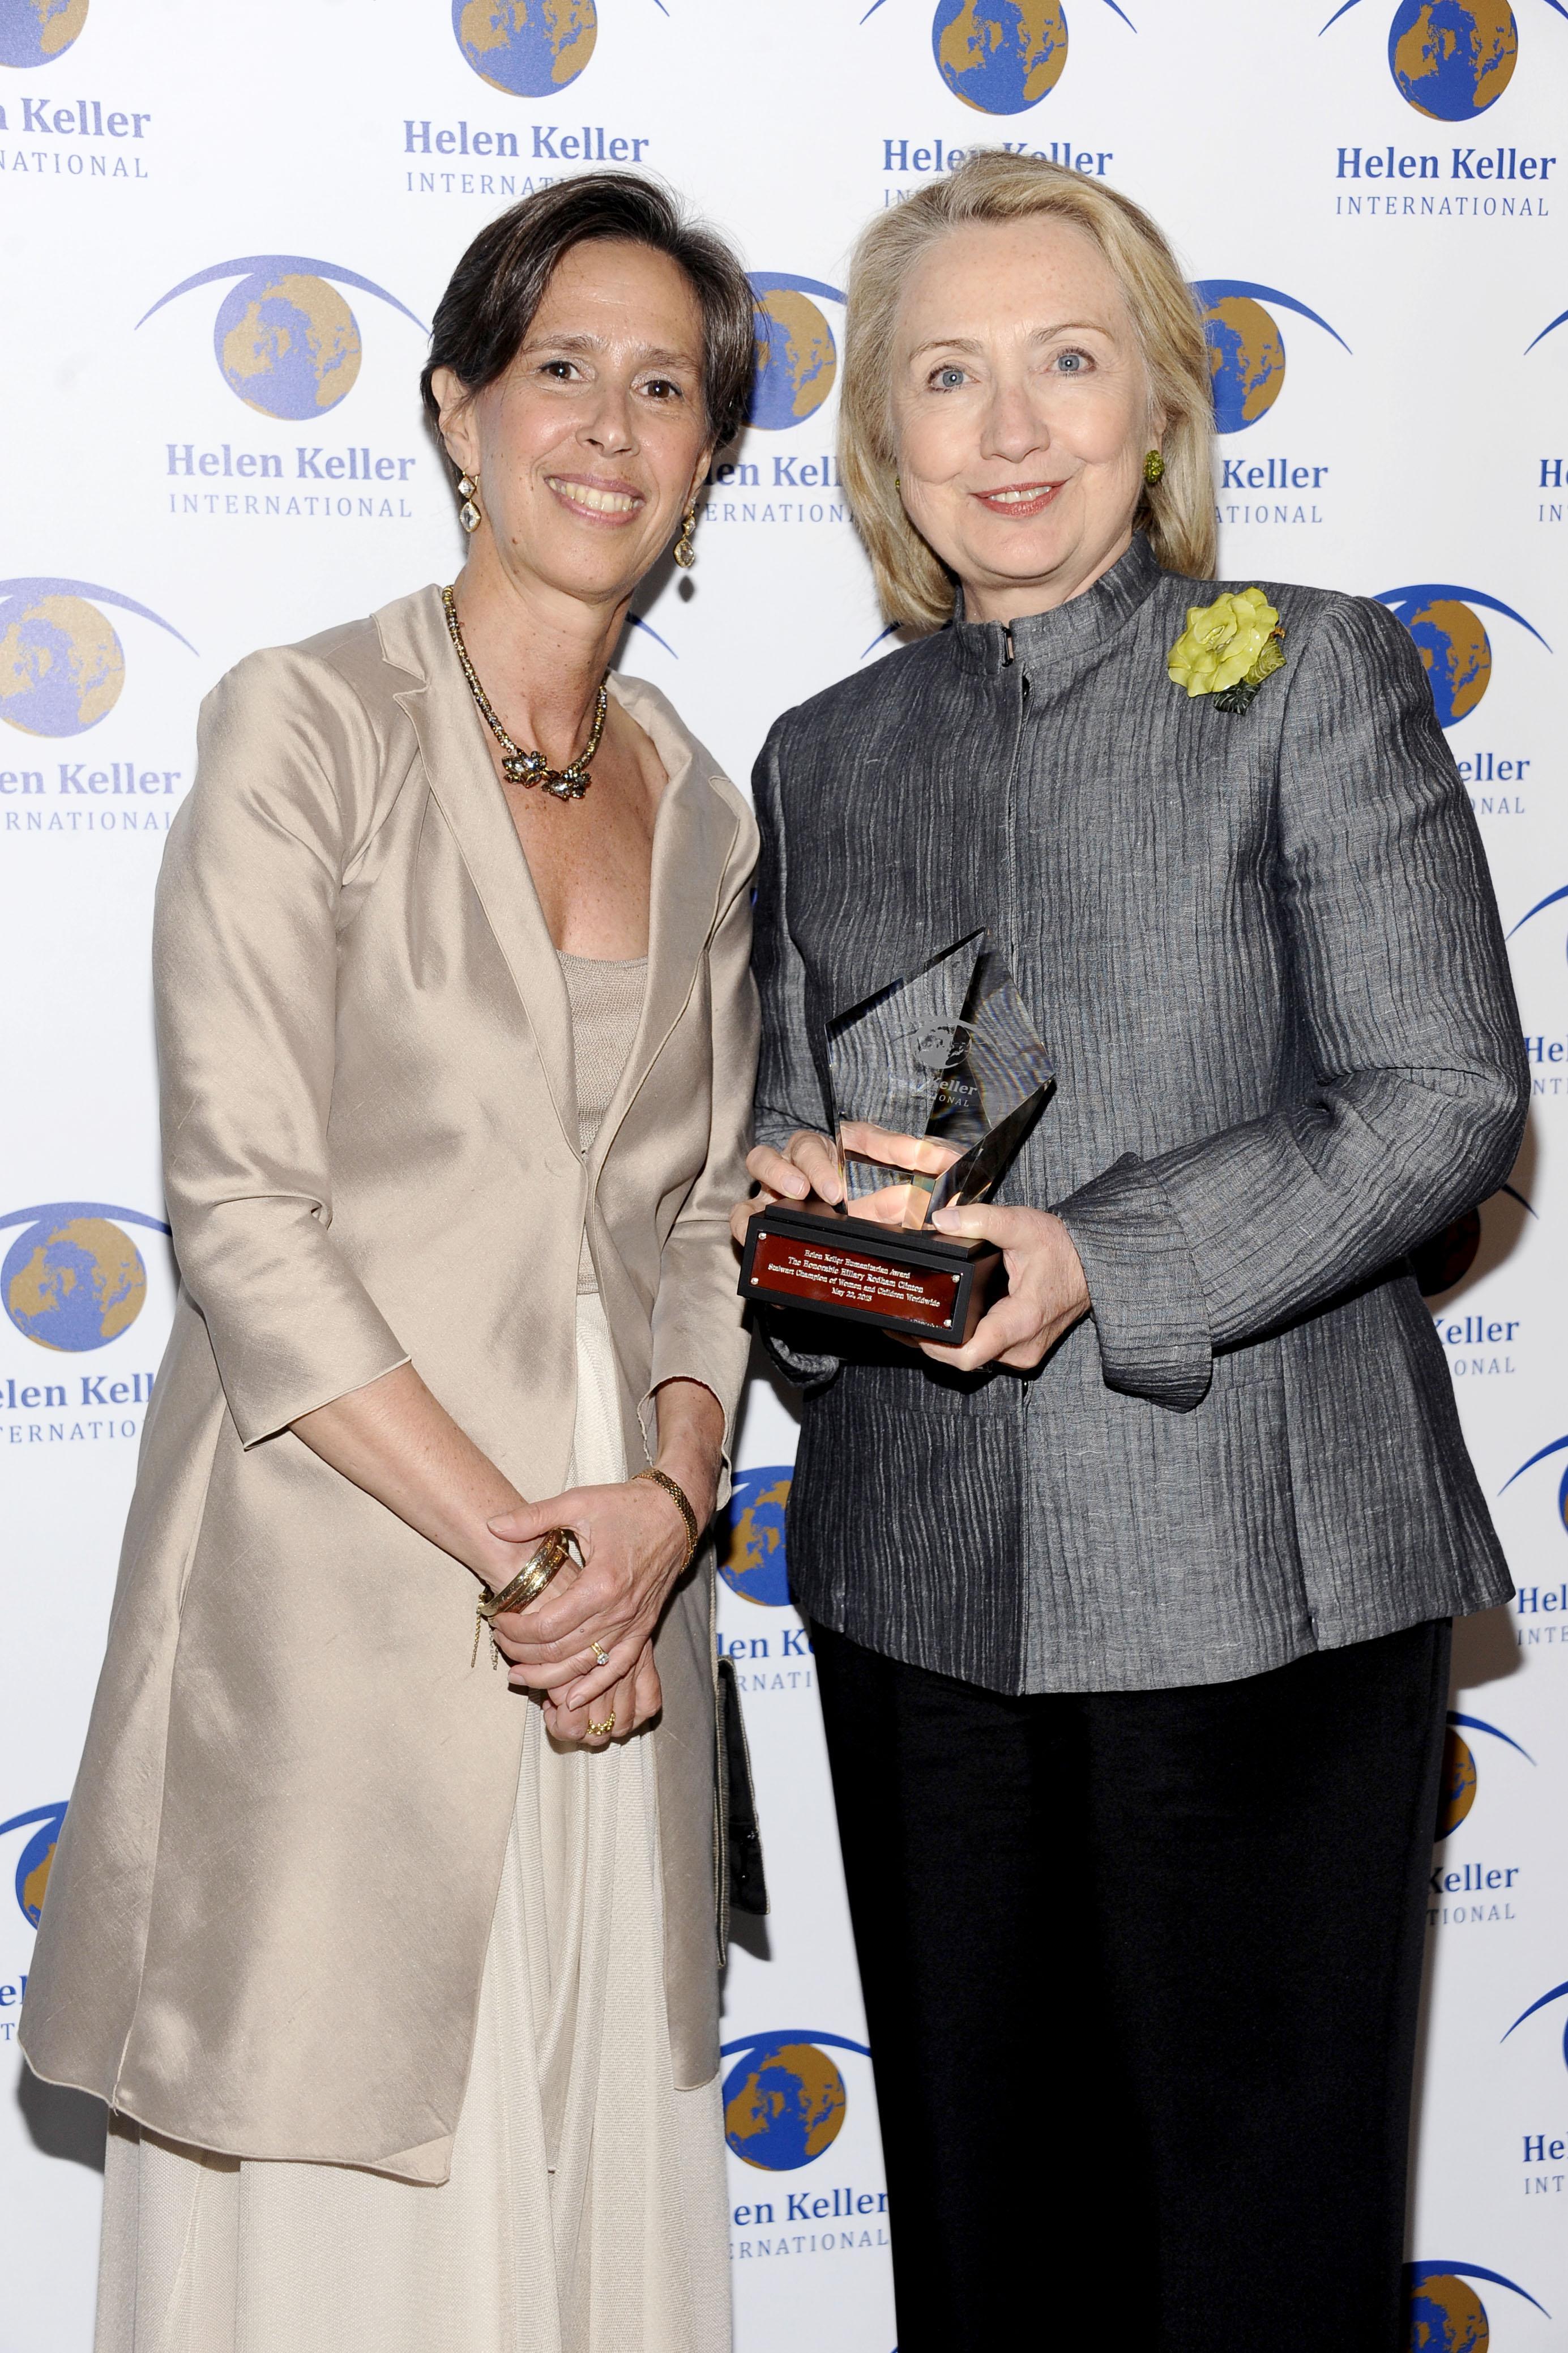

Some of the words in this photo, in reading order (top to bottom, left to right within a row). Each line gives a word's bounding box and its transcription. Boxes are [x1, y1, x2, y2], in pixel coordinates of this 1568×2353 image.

[20, 97, 151, 138] Keller
[403, 120, 519, 157] Helen
[531, 126, 649, 162] Keller
[1335, 147, 1439, 178] Helen
[1451, 148, 1556, 180] Keller
[407, 172, 567, 196] INTERNAT
[1336, 197, 1549, 215] INTERNATIONAL
[166, 444, 284, 478] Helen
[296, 447, 416, 481] Keller
[1221, 459, 1328, 488] Keller
[169, 493, 412, 517] INTERNATIONAL
[695, 503, 852, 522] ERNATION
[58, 763, 181, 794] Keller
[1456, 753, 1530, 781] eller
[788, 1256, 801, 1265] The
[0, 1420, 144, 1443] ERNATIO
[787, 2188, 888, 2221] Keller
